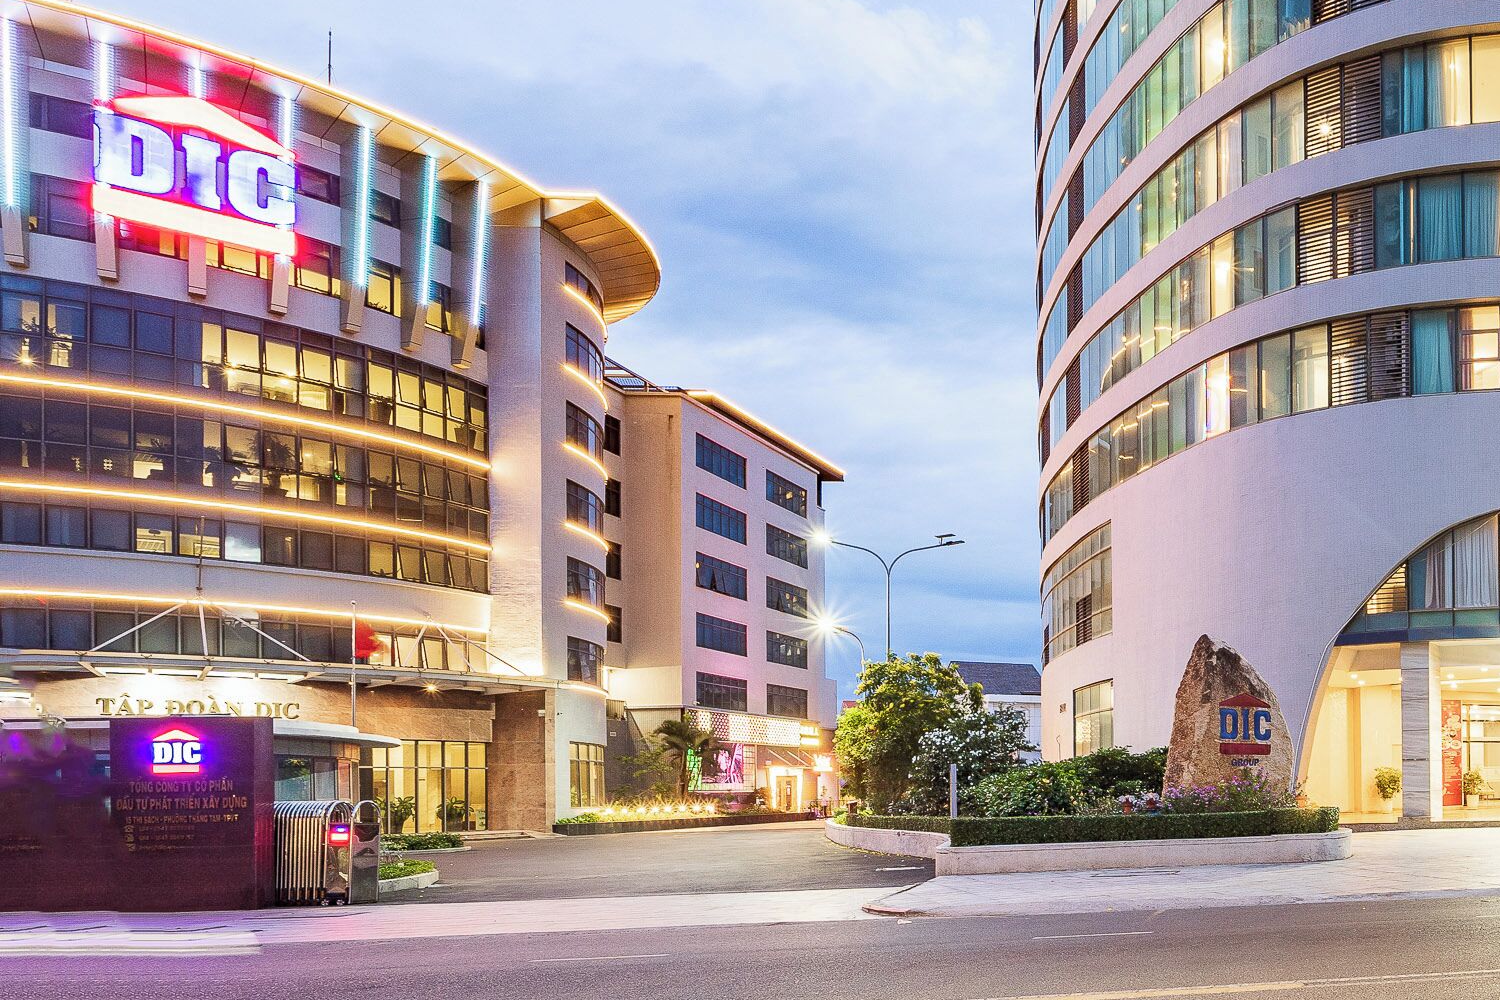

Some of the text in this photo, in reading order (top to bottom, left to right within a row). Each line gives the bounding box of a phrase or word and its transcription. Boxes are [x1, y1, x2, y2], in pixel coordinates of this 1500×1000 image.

[93, 110, 297, 225] DIC
[254, 702, 300, 720] DIC
[1219, 708, 1272, 741] DIC
[152, 741, 202, 764] DIC
[1231, 758, 1260, 767] GROUP
